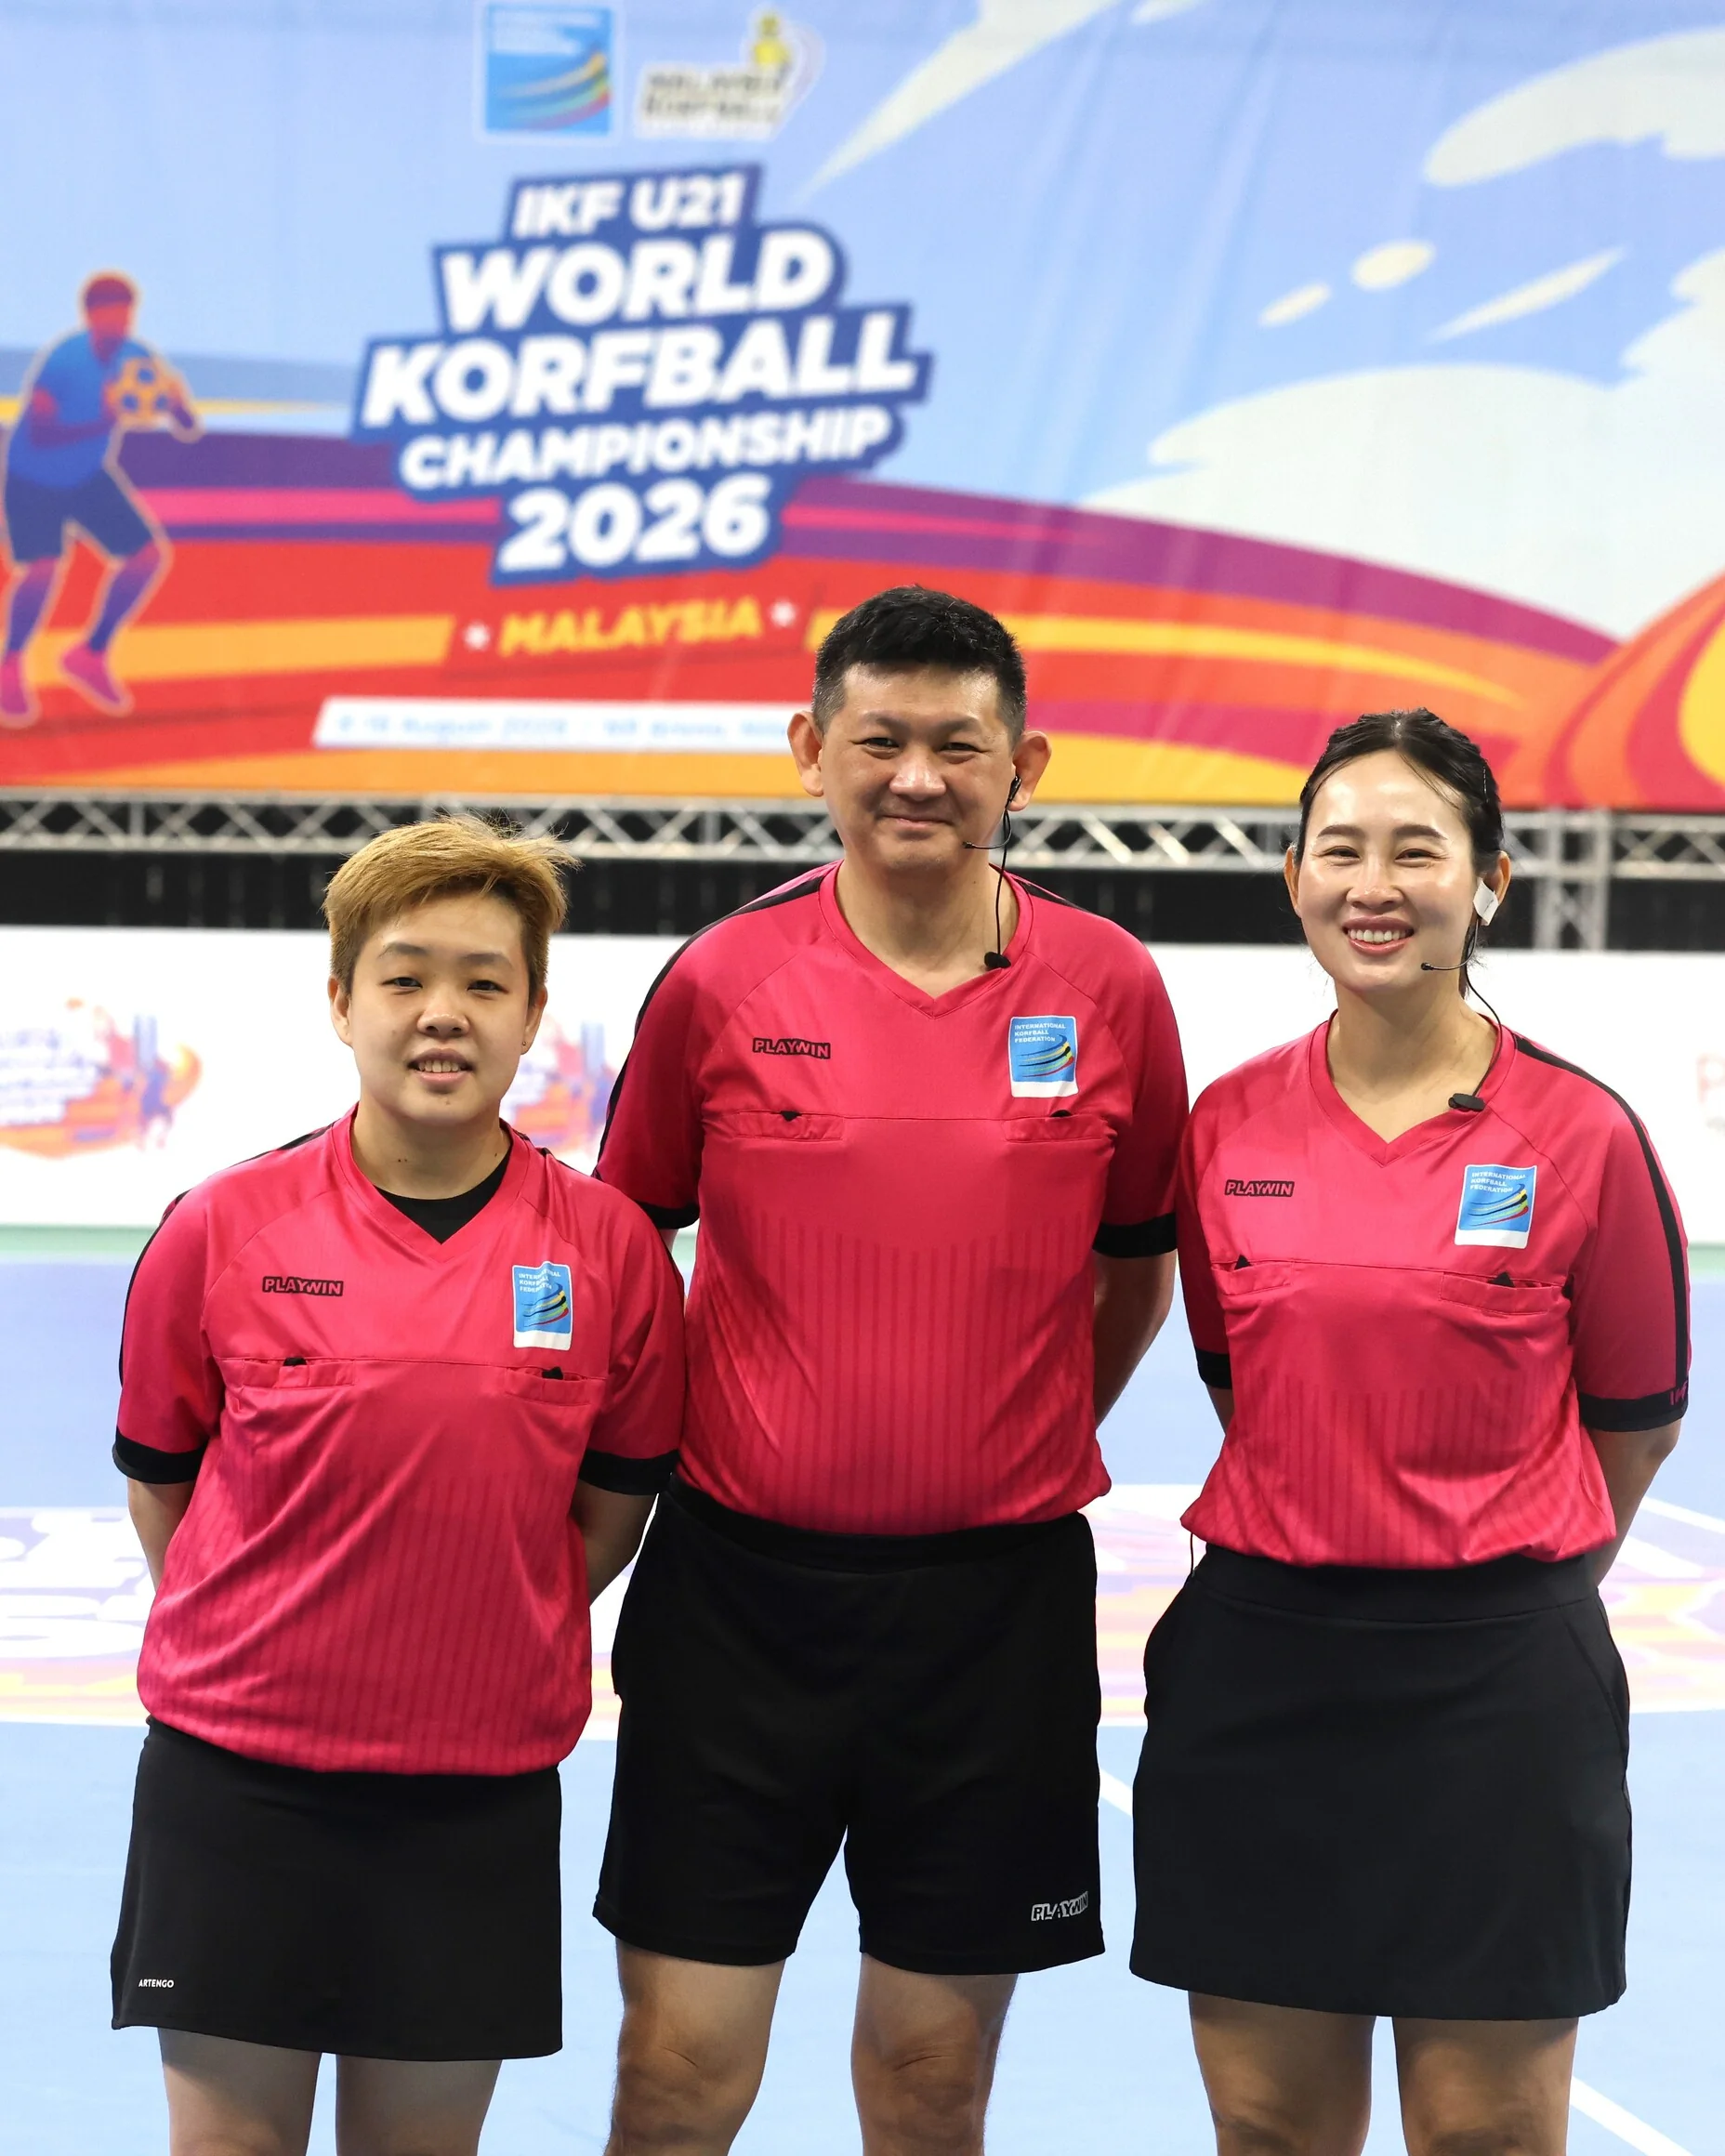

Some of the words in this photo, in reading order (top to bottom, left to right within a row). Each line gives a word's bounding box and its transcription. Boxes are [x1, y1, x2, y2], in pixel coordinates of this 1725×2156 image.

[513, 180, 623, 240] IKF
[631, 172, 746, 232] U21
[441, 230, 834, 334] WORLD
[362, 311, 916, 427] KORFBALL
[400, 405, 892, 488] CHAMPIONSHIP
[497, 472, 771, 572] 2026
[498, 596, 763, 658] MALAYSIA
[754, 1039, 829, 1058] PLAYWIN
[1226, 1181, 1294, 1196] PLAYWIN
[1469, 1184, 1514, 1193] FEDERATION
[1470, 1177, 1508, 1187] KORFBALL
[1471, 1172, 1526, 1180] INTERNATIONAL
[264, 1277, 343, 1295] PLAYWIN
[1031, 1890, 1088, 1922] PLAYWIN
[138, 1979, 175, 1989] ARTENGO
